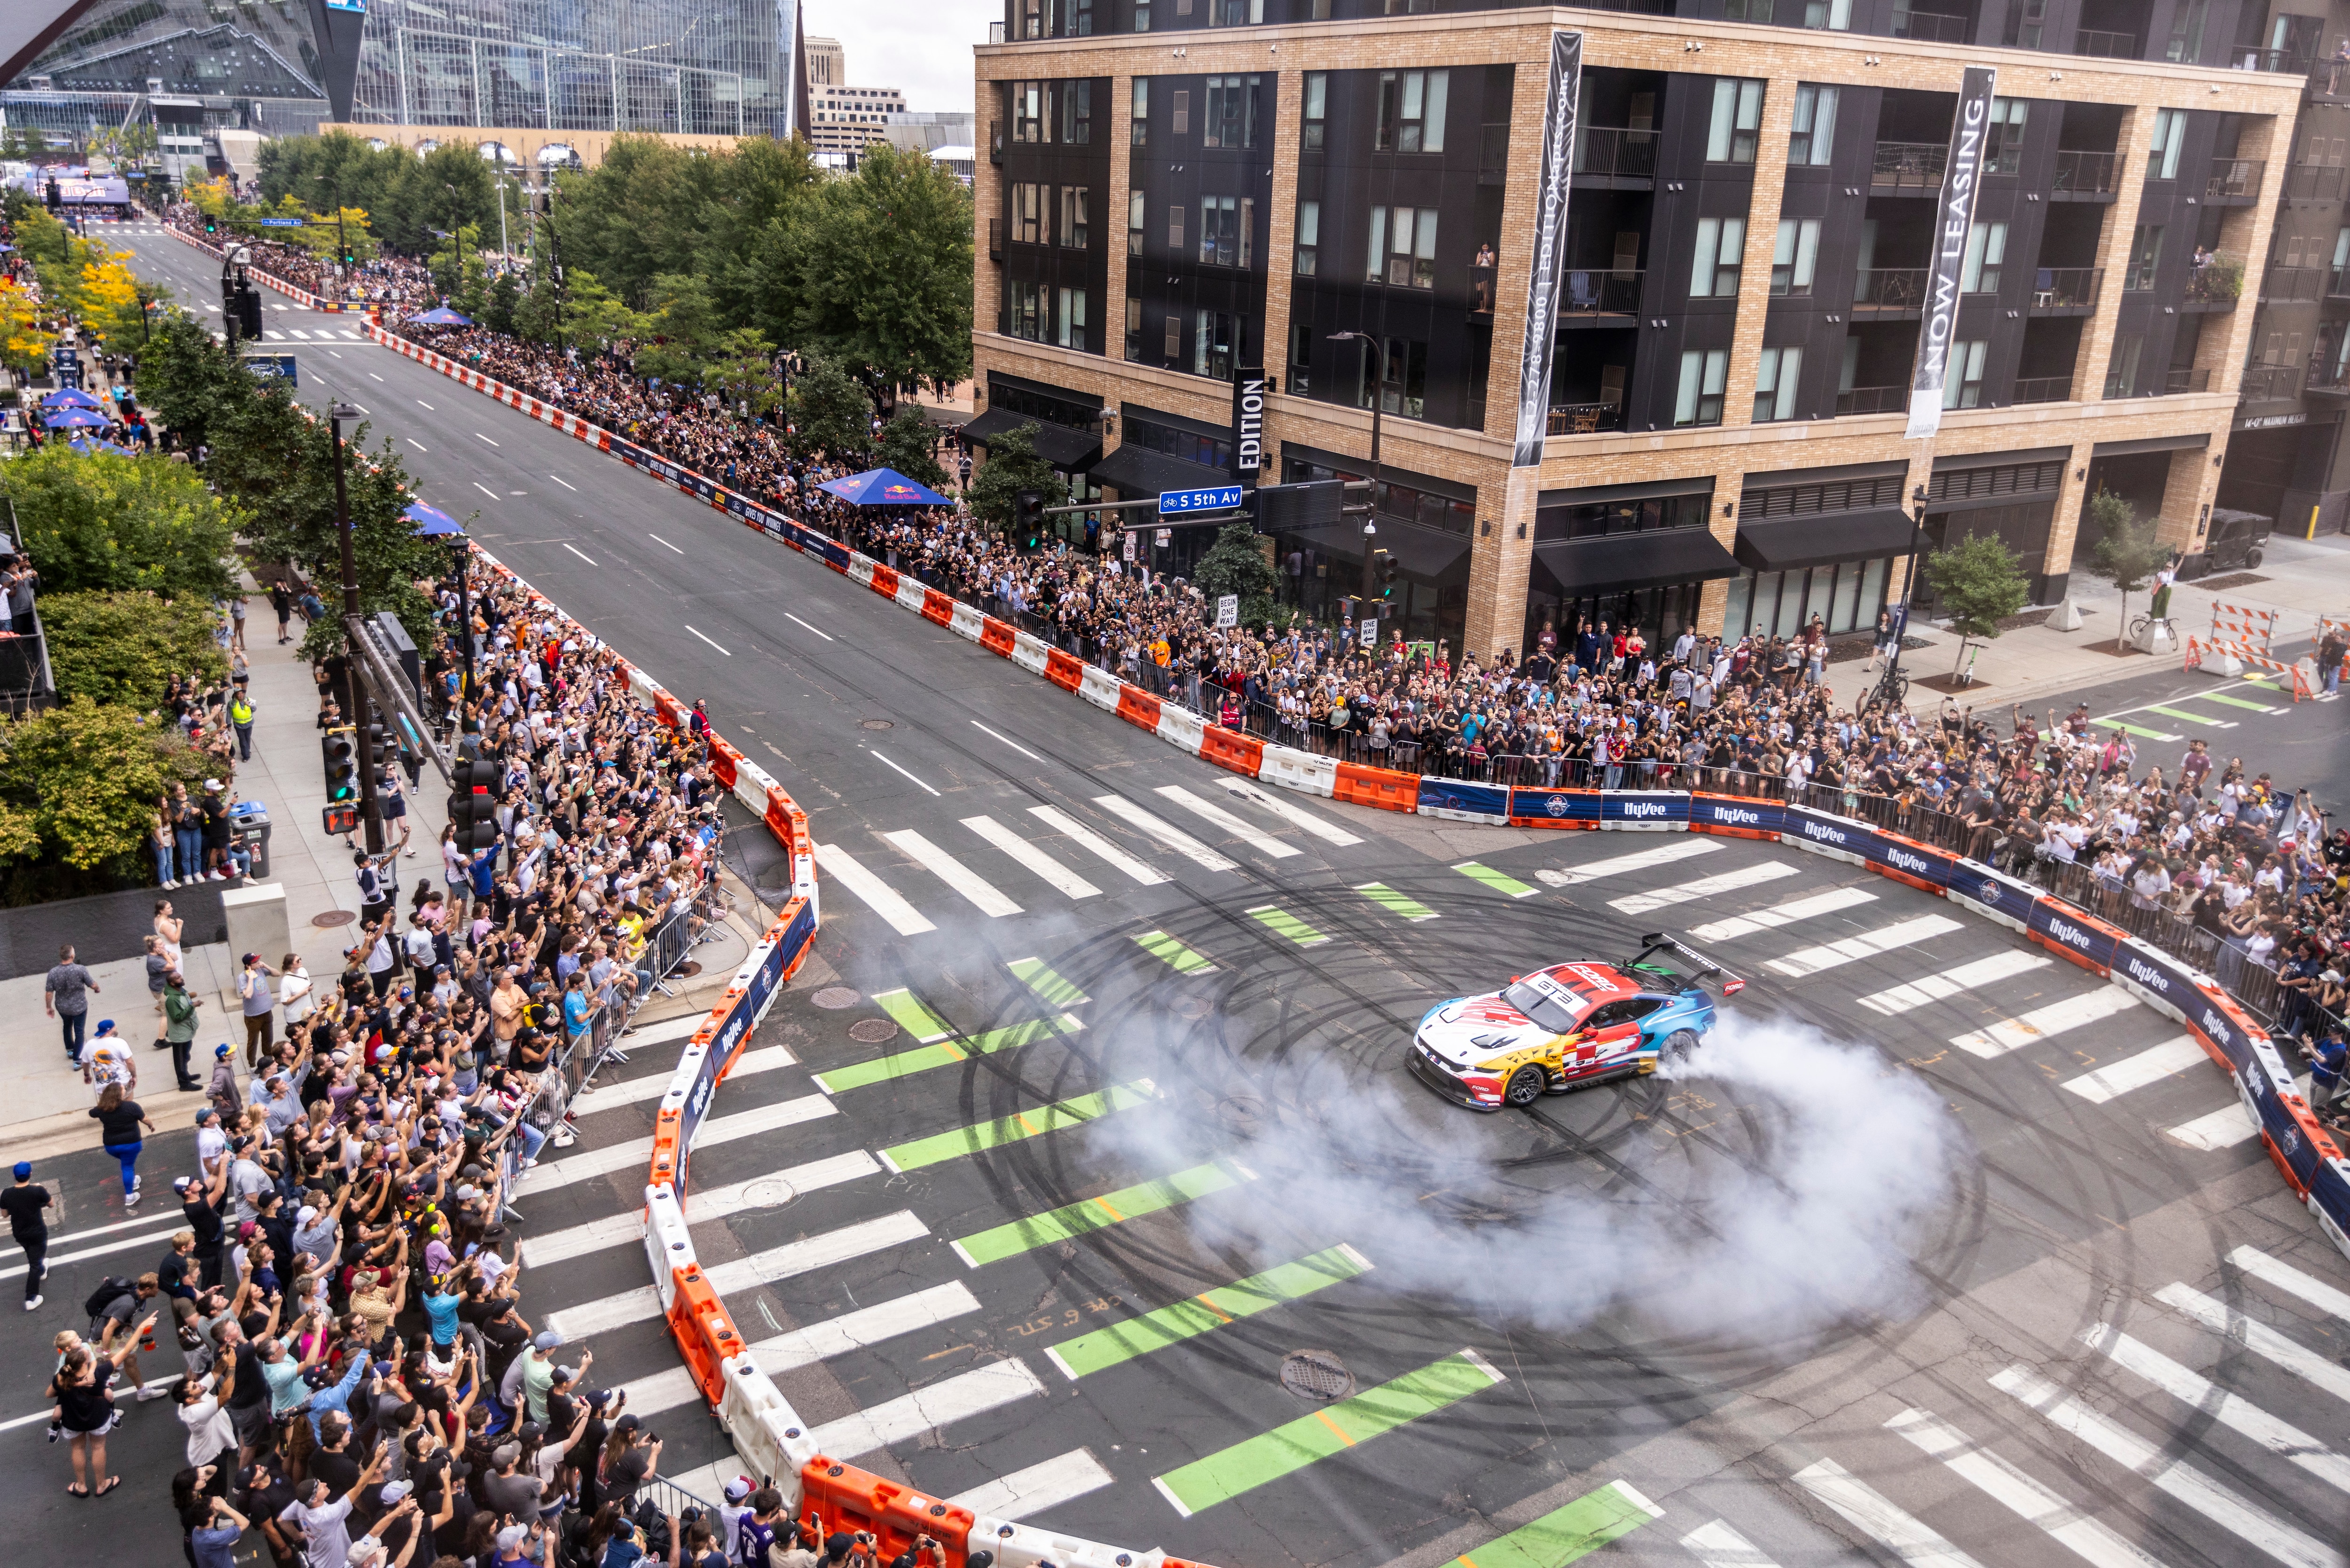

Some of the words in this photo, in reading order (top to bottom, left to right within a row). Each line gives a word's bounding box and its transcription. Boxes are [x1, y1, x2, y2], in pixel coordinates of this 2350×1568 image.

[1924, 274, 1955, 370] NOW
[1942, 100, 1983, 257] LEASING
[1525, 297, 1547, 436] 612-278-9800
[1239, 380, 1263, 469] EDITION
[2263, 415, 2287, 426] MAXIMUM
[2287, 414, 2307, 424] HEIGHT
[650, 459, 659, 470] GIVES
[1180, 495, 1188, 507] S
[1194, 493, 1216, 506] 5th
[1221, 492, 1238, 504] Av
[745, 507, 756, 519] GIVES
[1221, 598, 1236, 607] BEGIN
[1222, 607, 1234, 615] ONE
[1220, 616, 1235, 625] WAY
[344, 812, 353, 826] 10
[1676, 945, 1717, 970] MUSTAN
[1572, 965, 1619, 991] FORD
[1538, 981, 1573, 1004] GT3
[1544, 978, 1577, 999] MUSTANG
[1724, 983, 1743, 992] FORD
[764, 1529, 774, 1540] 18
[921, 1524, 951, 1540] VALTIR
